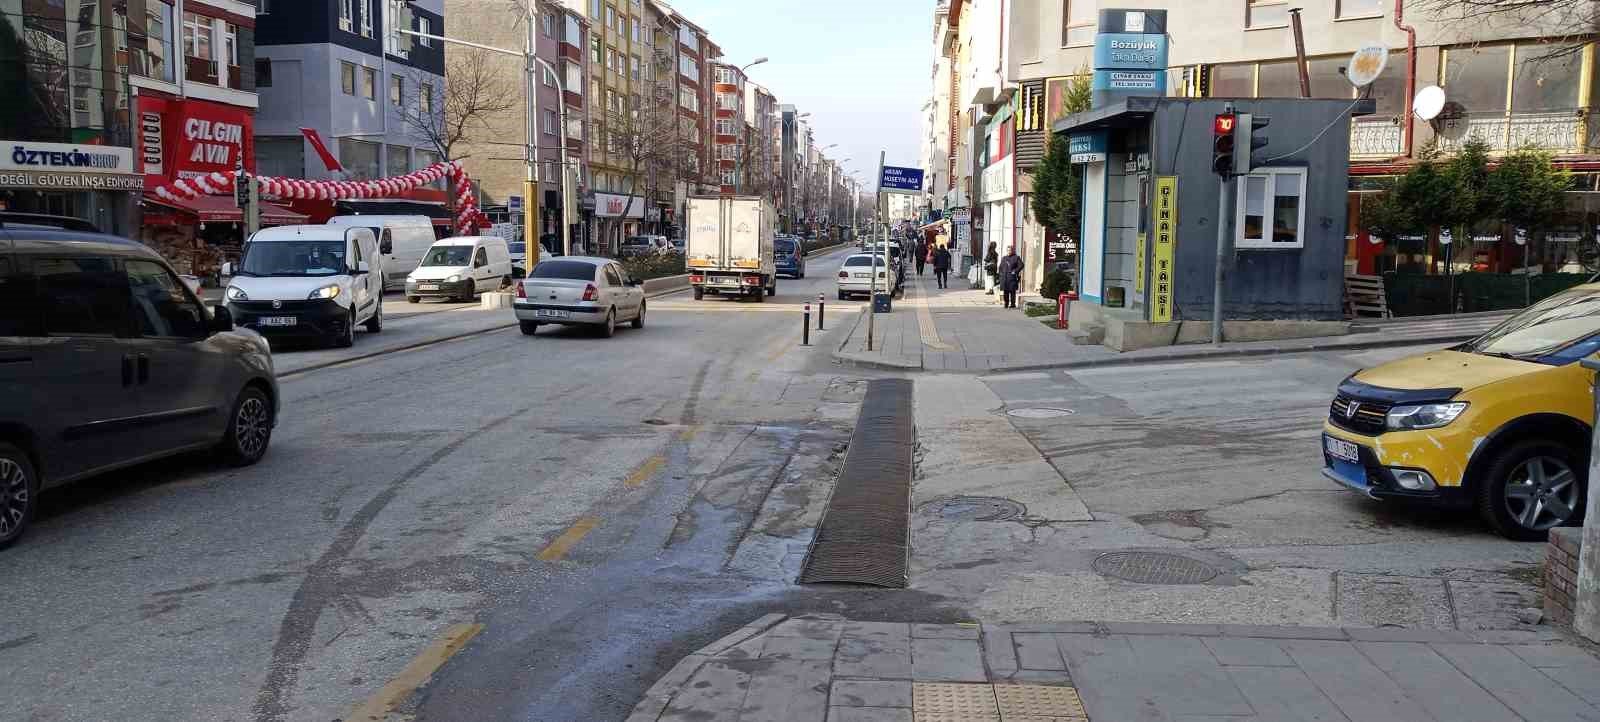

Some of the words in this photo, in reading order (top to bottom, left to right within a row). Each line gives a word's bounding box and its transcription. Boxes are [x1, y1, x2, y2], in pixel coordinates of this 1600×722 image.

[185, 118, 242, 144] ÇILGIN
[190, 142, 229, 165] AVM
[0, 173, 33, 186] DEĞİL
[38, 174, 79, 186] GÜVEN
[82, 174, 105, 189] İNŞA
[107, 175, 144, 189] EDİYORUZ
